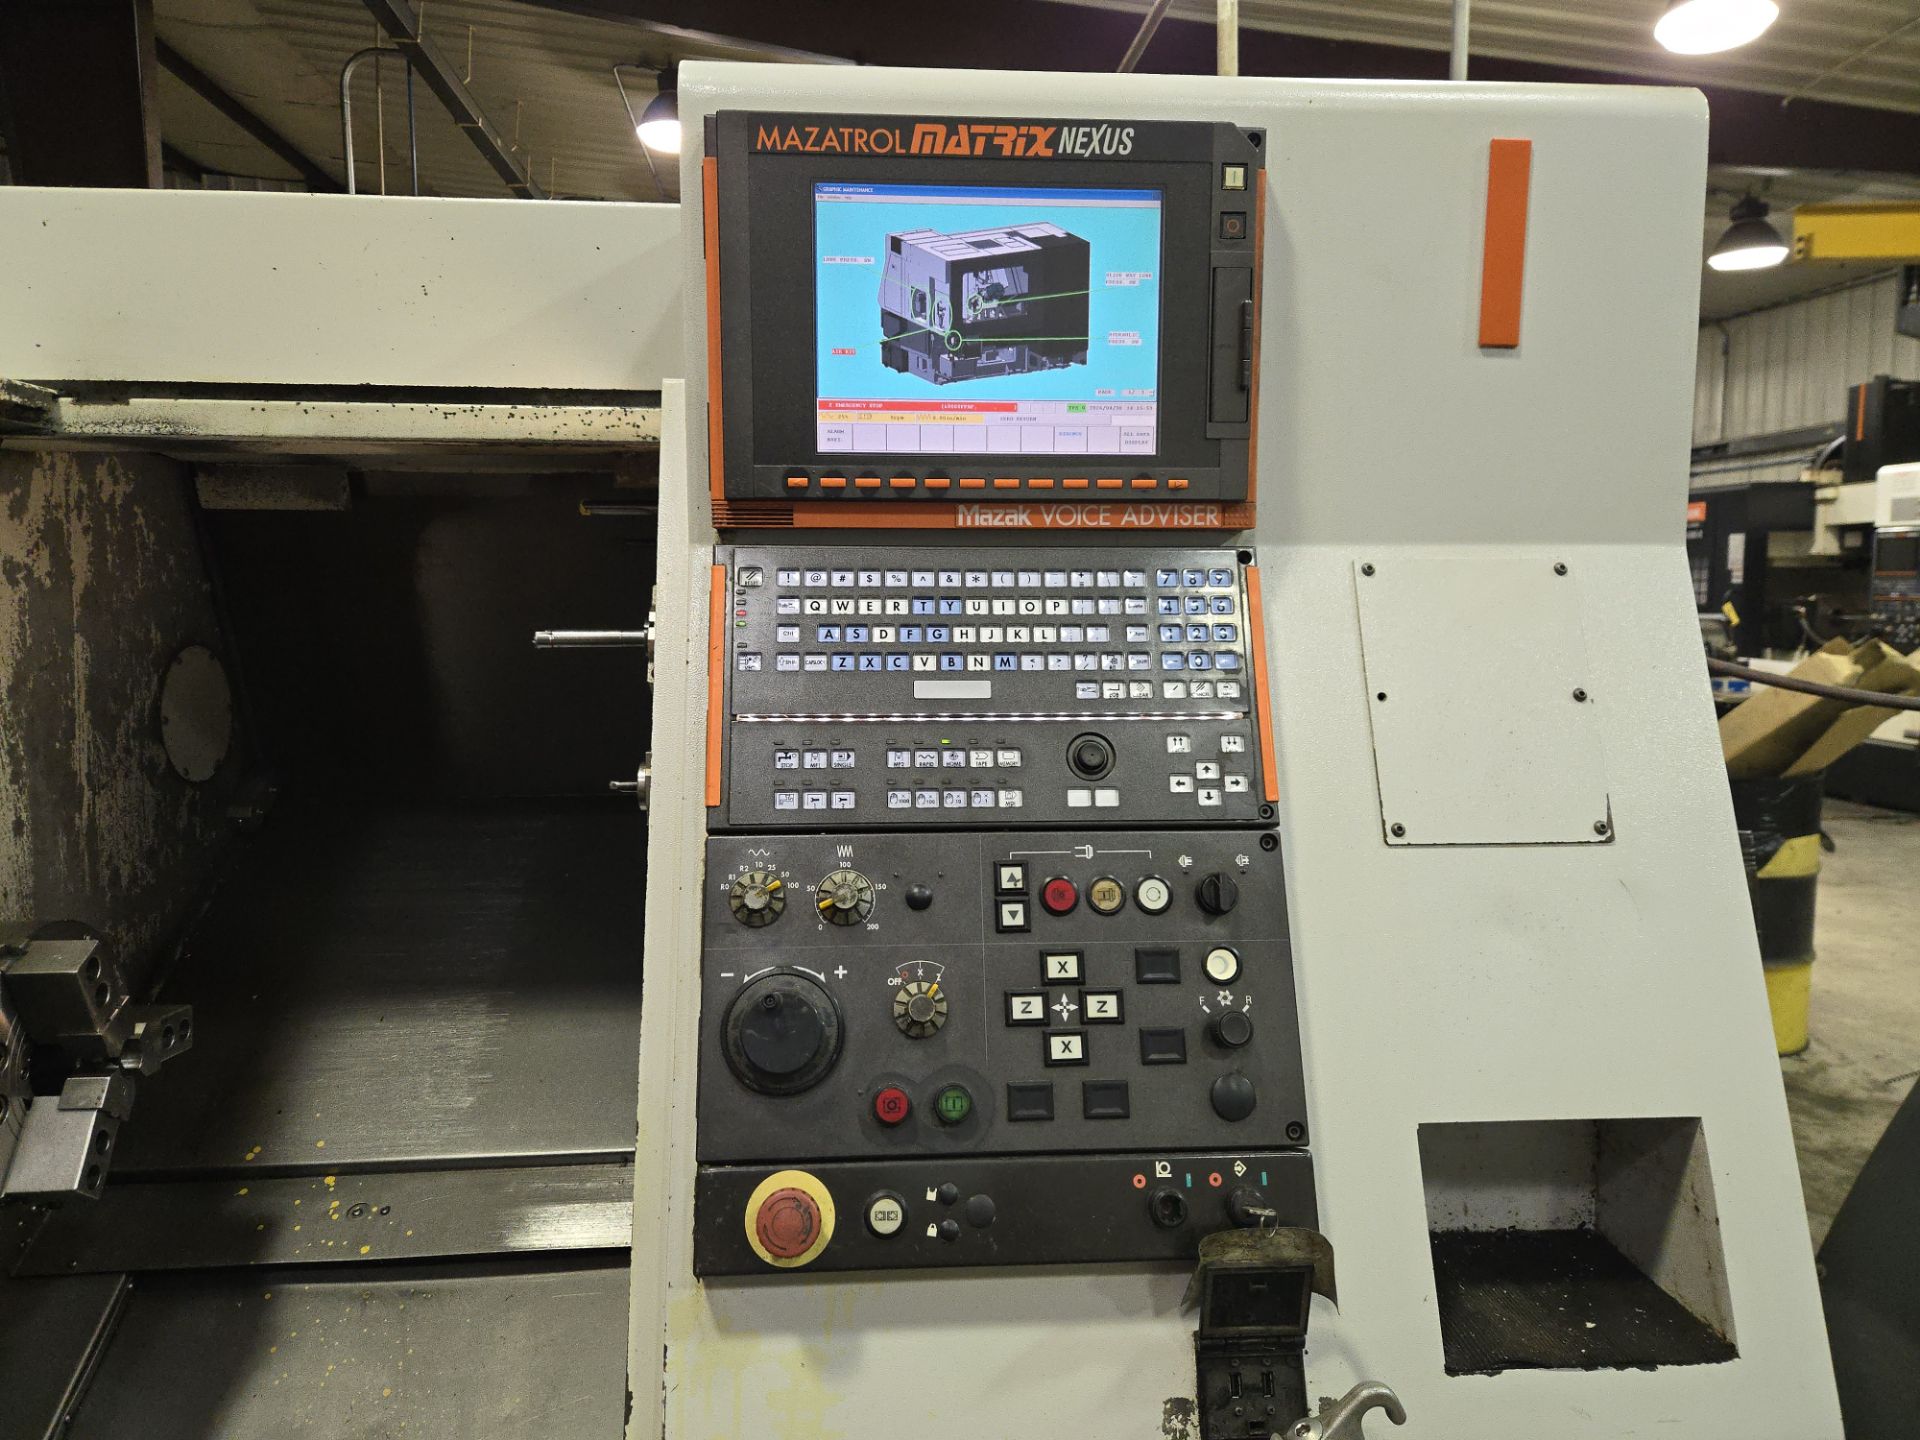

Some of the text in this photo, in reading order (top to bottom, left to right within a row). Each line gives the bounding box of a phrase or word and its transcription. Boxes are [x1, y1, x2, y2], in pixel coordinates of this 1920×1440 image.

[756, 123, 1135, 158] MAZATROL MATRIX NEXUS
[957, 503, 1220, 527] Mazak VOICE ADVISER
[810, 600, 821, 612] Q
[836, 600, 850, 611] W
[893, 601, 900, 611] R
[920, 601, 927, 611] T
[946, 601, 954, 611] Y
[973, 601, 981, 612] U
[1024, 601, 1035, 612] O
[1053, 601, 1060, 611] P
[1163, 600, 1173, 612] 4
[1191, 600, 1199, 612] 5
[1216, 600, 1226, 612] 6
[824, 629, 834, 640] A
[853, 629, 860, 639] S
[879, 629, 888, 639] D
[932, 629, 943, 640] G
[960, 630, 969, 639] H
[1014, 630, 1022, 639] K
[1193, 628, 1202, 640] 2
[1219, 627, 1228, 640] 3
[838, 658, 847, 668] Z
[865, 658, 874, 668] X
[893, 657, 902, 668] C
[920, 657, 929, 667] V
[948, 657, 956, 667] B
[974, 657, 983, 668] N
[999, 657, 1011, 668] M
[1194, 655, 1203, 667] 0
[866, 923, 880, 931] 200
[1057, 961, 1068, 974] X
[887, 977, 902, 986] OFF
[1245, 995, 1252, 1004] R
[1020, 1001, 1033, 1014] Z
[1096, 1000, 1108, 1013] Z
[1061, 1040, 1073, 1054] X
